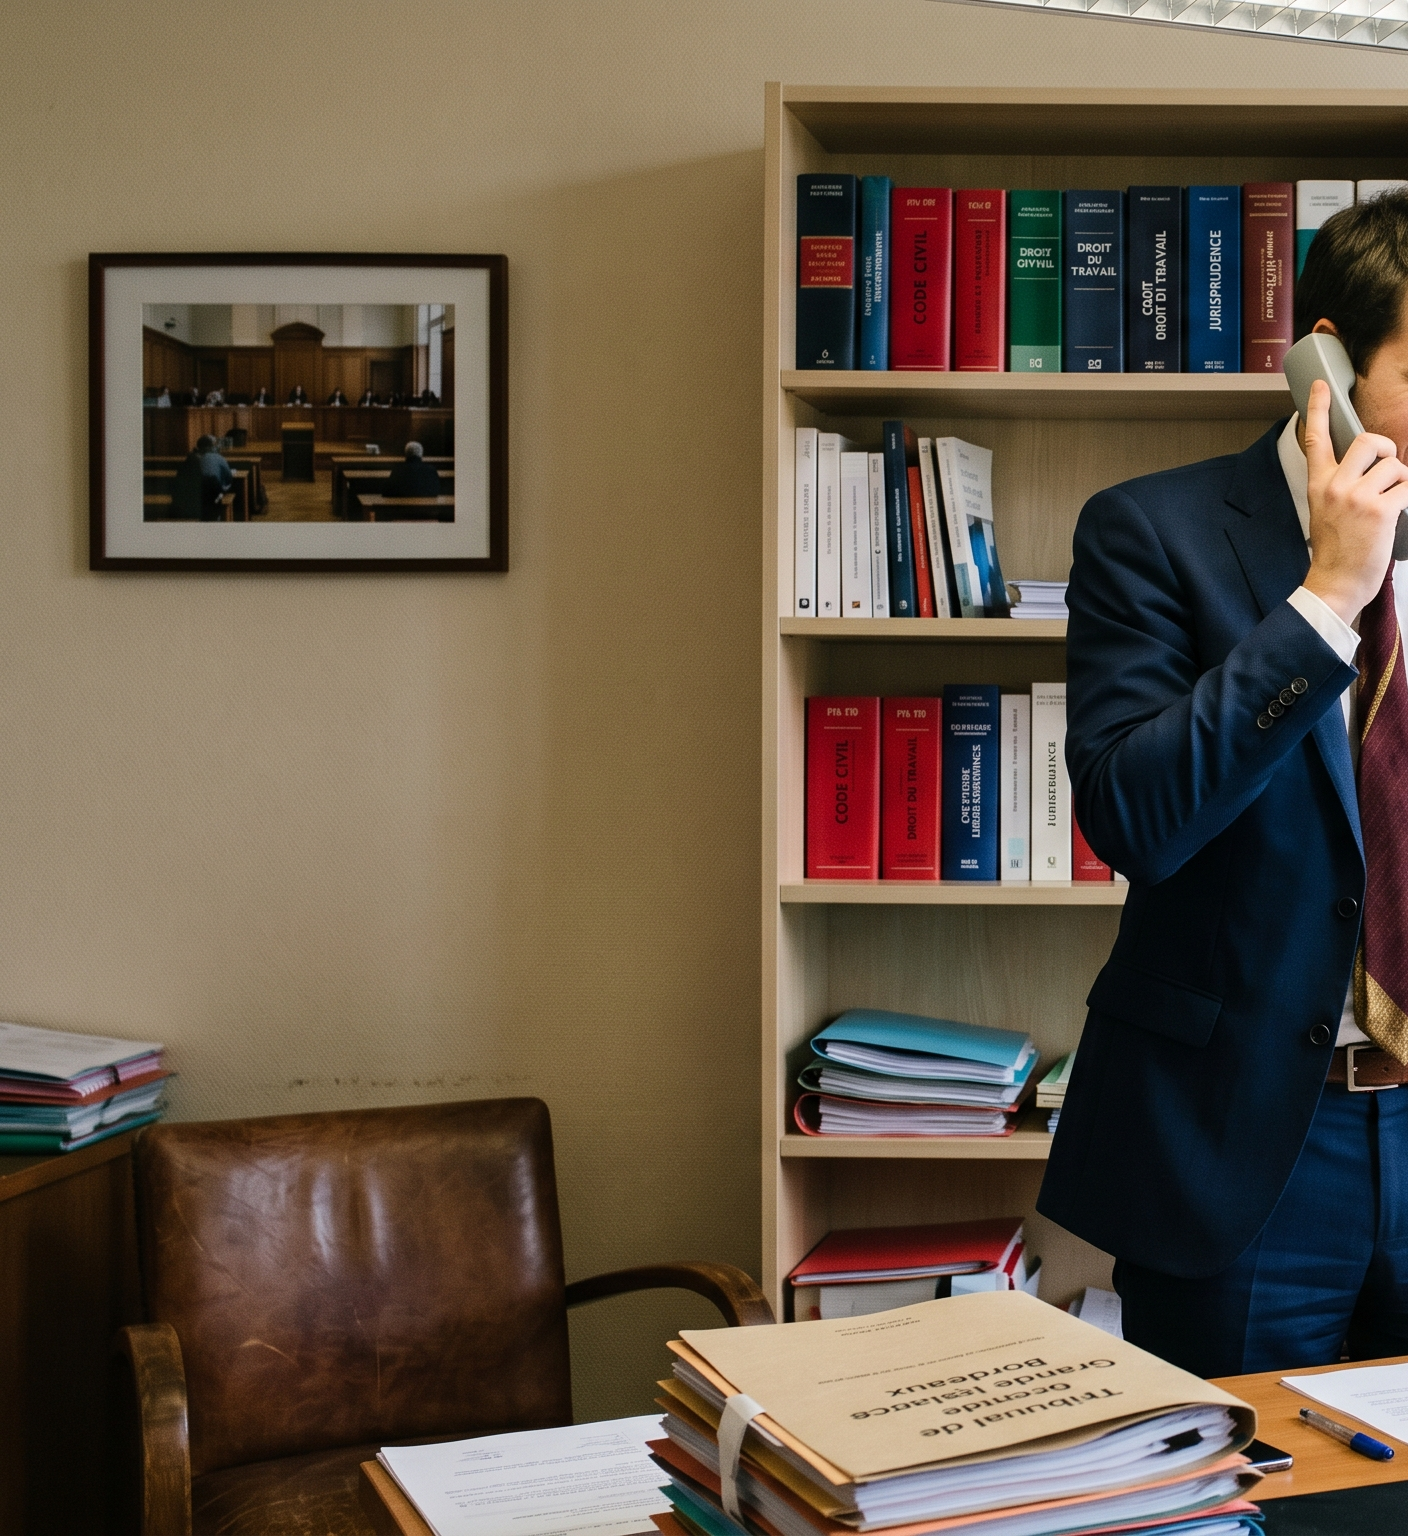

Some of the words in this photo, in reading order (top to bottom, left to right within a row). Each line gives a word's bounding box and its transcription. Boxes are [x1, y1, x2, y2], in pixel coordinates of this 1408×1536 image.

[913, 230, 927, 273] CIVIL
[1077, 243, 1112, 253] DROIT
[1087, 255, 1102, 264] DU
[1070, 266, 1117, 276] TRAVAIL
[1209, 230, 1222, 332] JURISPRUDENCE
[913, 280, 927, 325] CODE
[835, 740, 848, 778] CIVIL
[907, 737, 917, 782] TRAVAIL
[835, 783, 848, 824] CODE
[907, 787, 917, 802] DU
[907, 807, 917, 840] DROIT
[886, 1357, 1048, 1398] Bordeaux
[993, 1358, 1116, 1388] Grande
[920, 1422, 963, 1438] de
